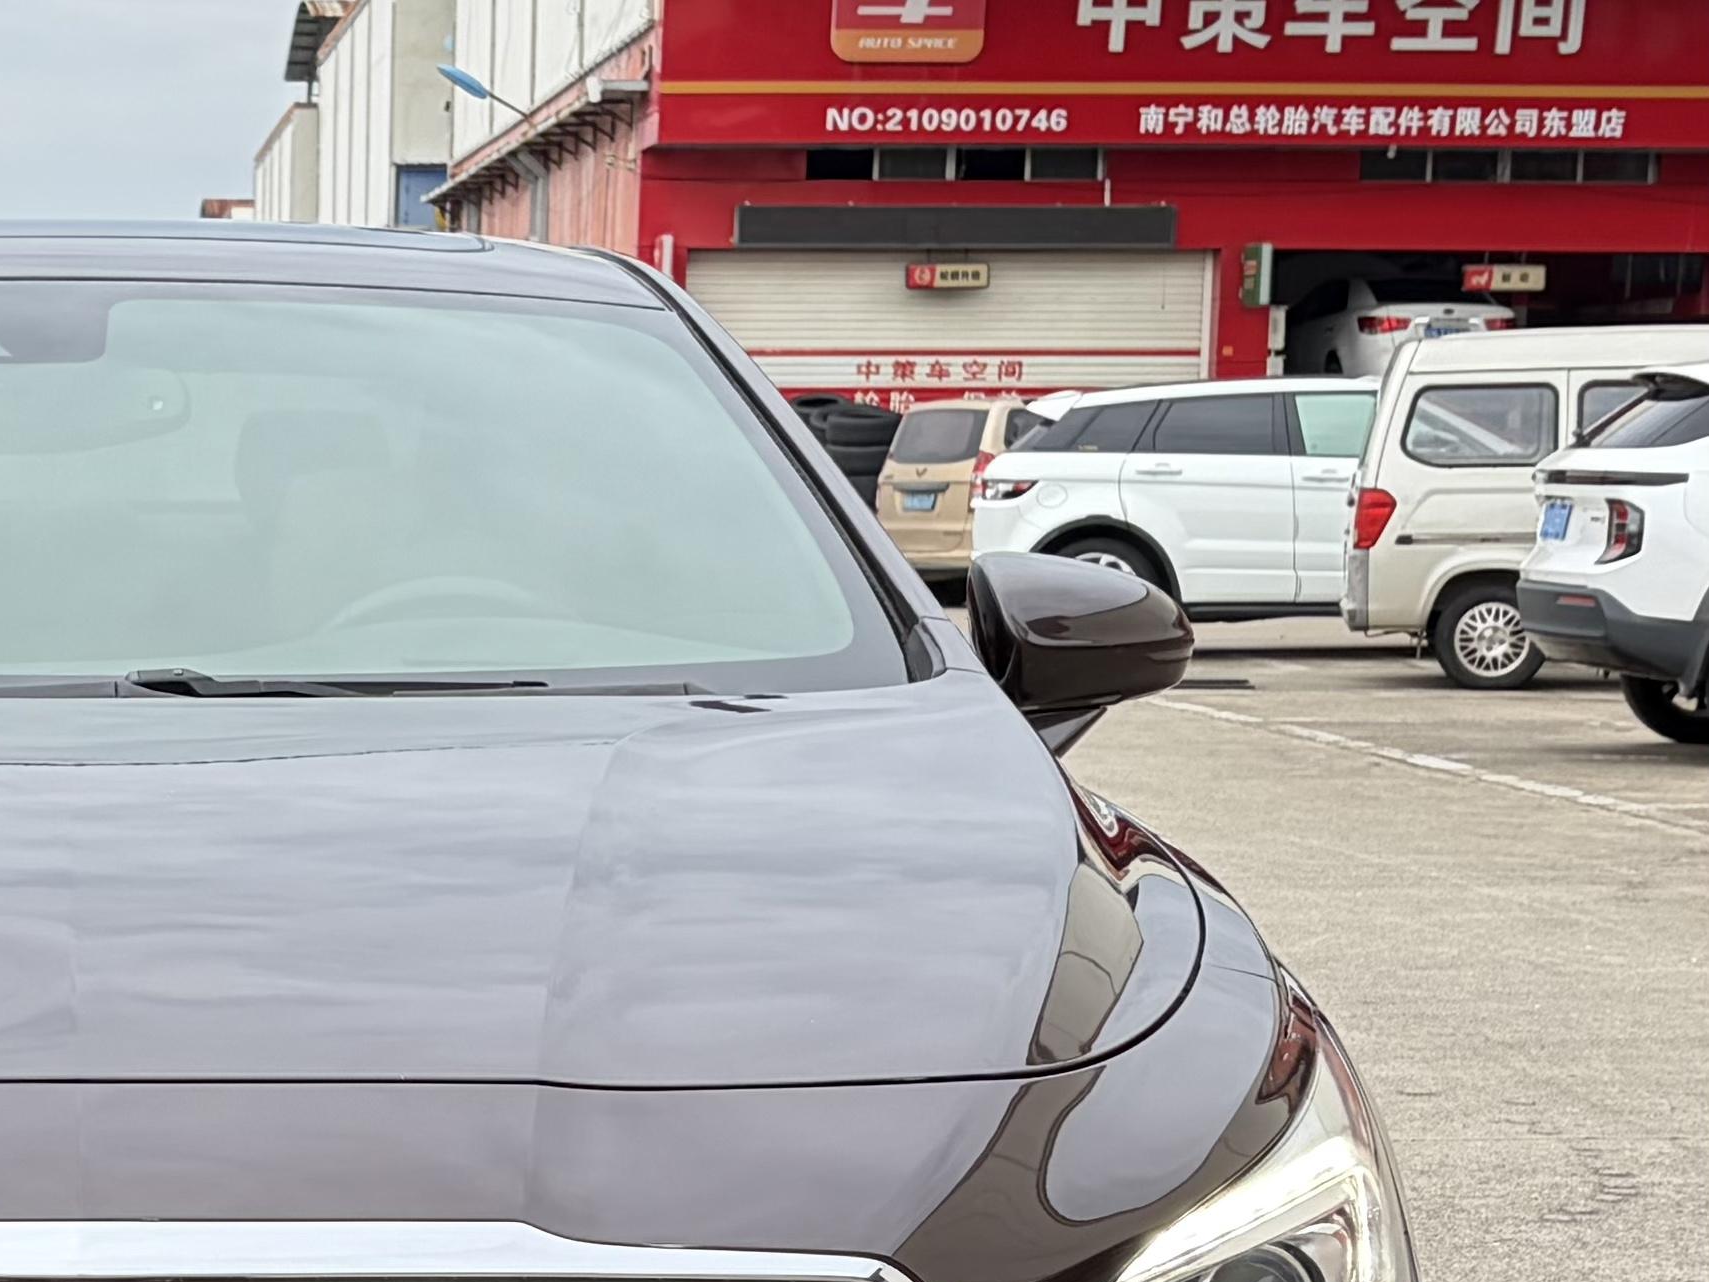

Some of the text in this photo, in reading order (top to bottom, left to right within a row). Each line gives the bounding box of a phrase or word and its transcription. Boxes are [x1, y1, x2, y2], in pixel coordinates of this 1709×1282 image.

[858, 37, 902, 49] AUTO
[825, 107, 1068, 131] NO:2109010746
[1139, 104, 1627, 138] 南宁和总轮胎汽车配件有限公司东盟店
[856, 360, 1023, 382] 中策车空间
